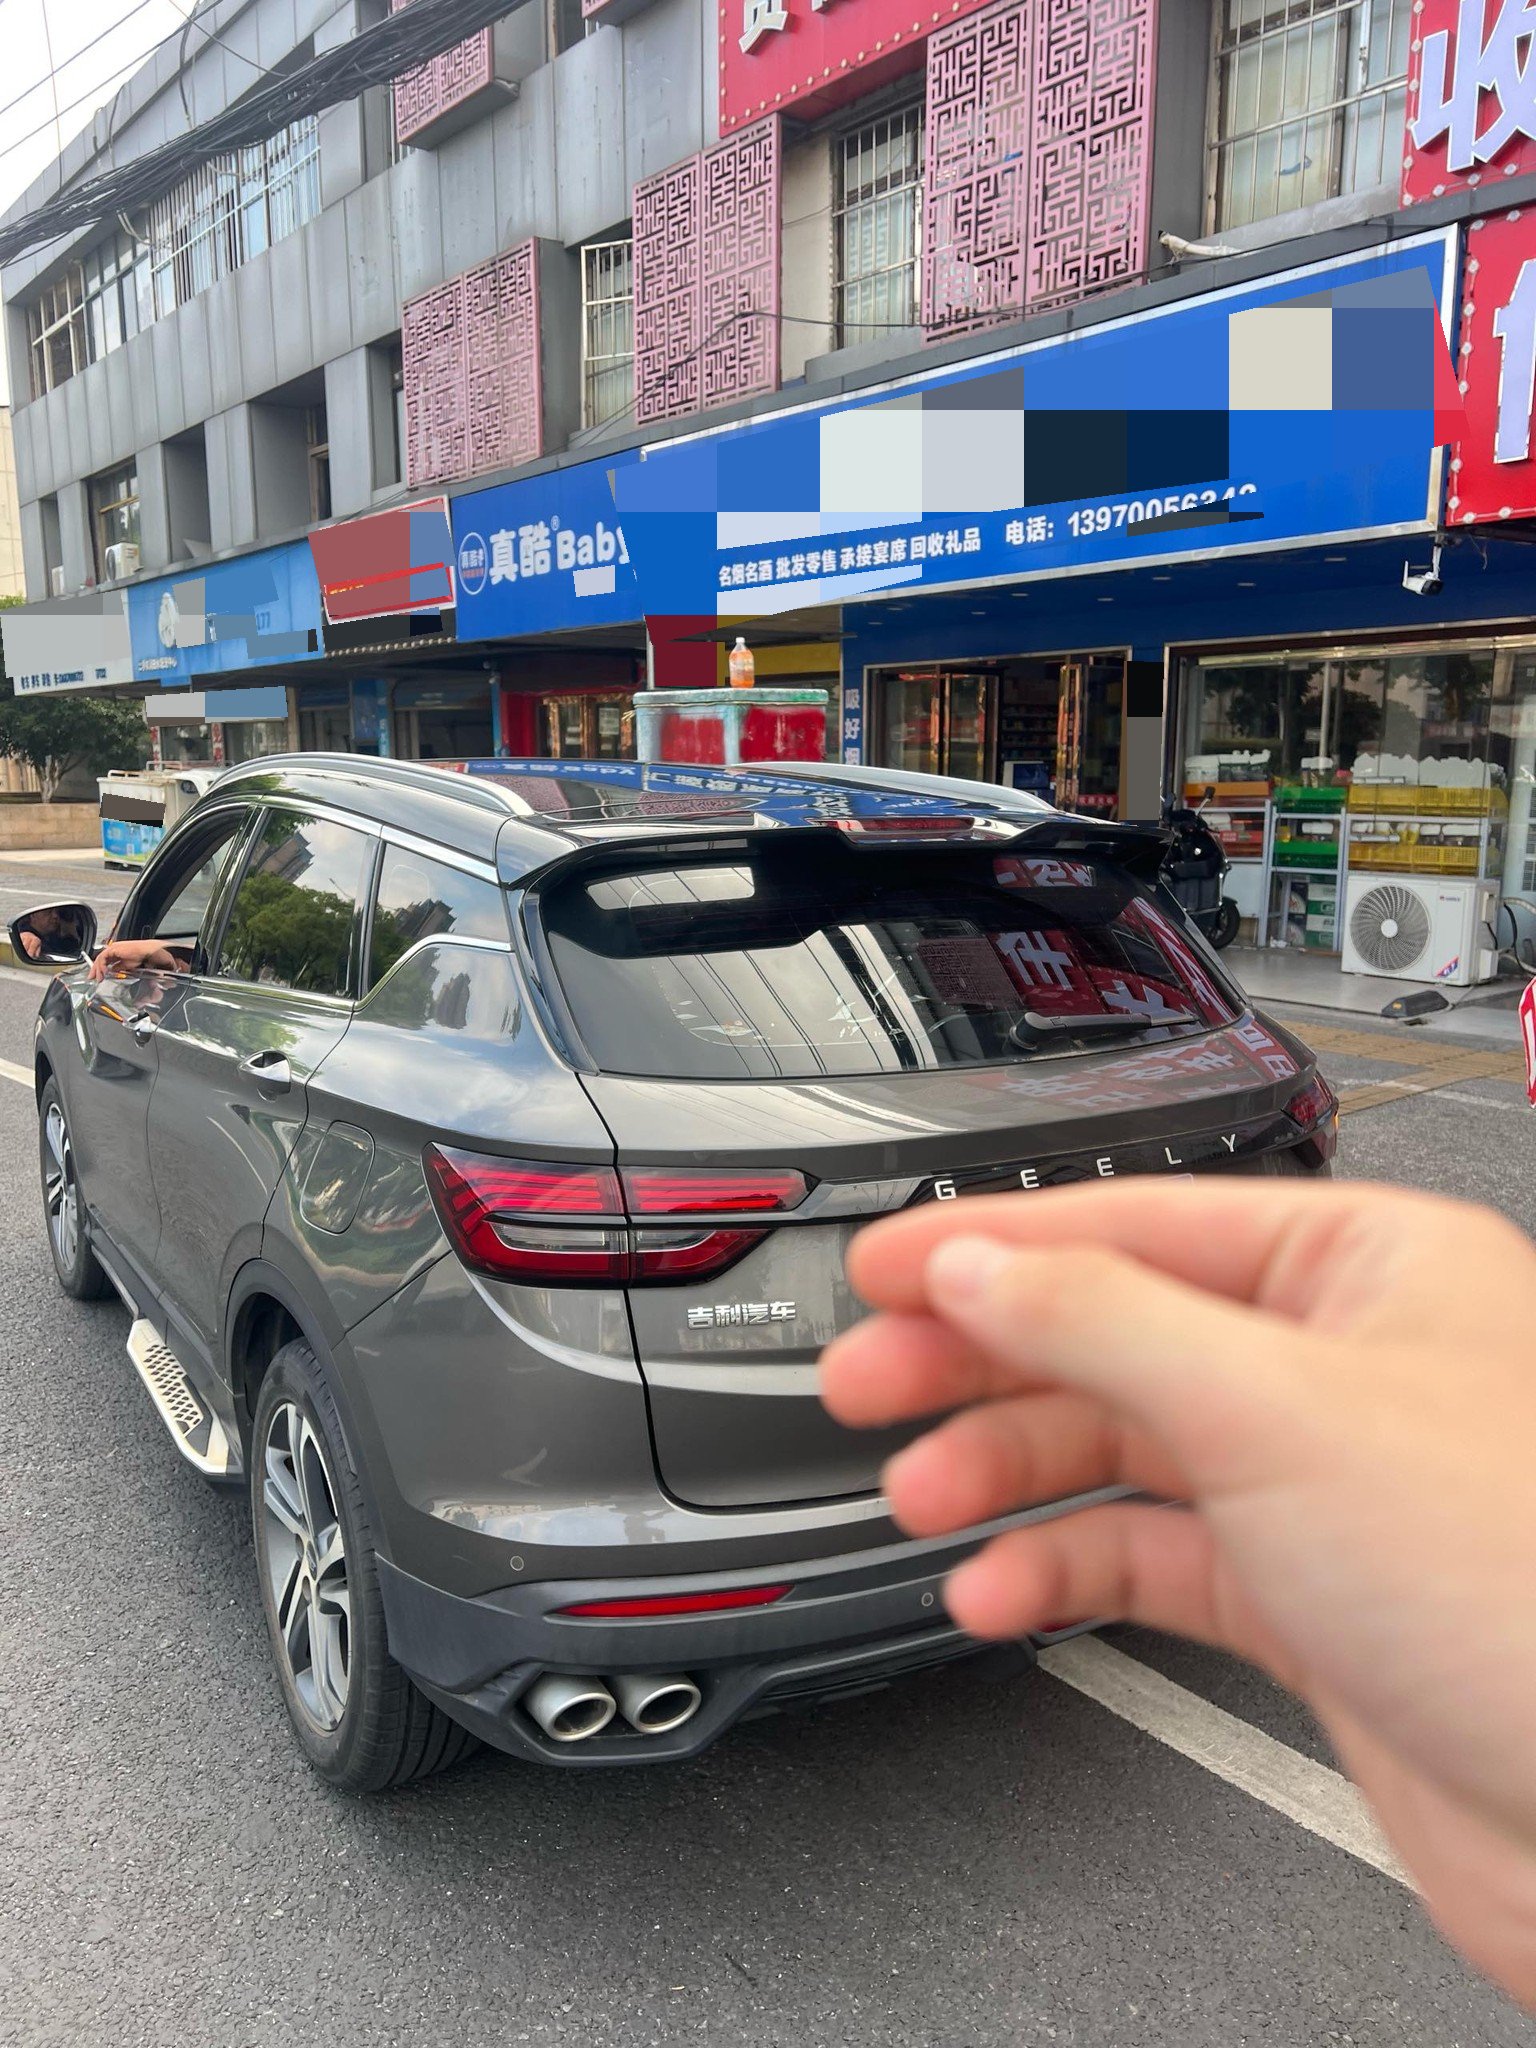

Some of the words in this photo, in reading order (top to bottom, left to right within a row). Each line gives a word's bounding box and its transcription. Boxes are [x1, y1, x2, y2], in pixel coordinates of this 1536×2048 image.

[489, 520, 552, 586] 真酷
[718, 559, 773, 587] 名烟名酒
[776, 549, 837, 579] 批发零售
[840, 537, 907, 569] 承接宴席
[910, 527, 981, 560] 回收礼品
[934, 1133, 1237, 1200] GEELY
[688, 1301, 796, 1330] 吉利汽车
